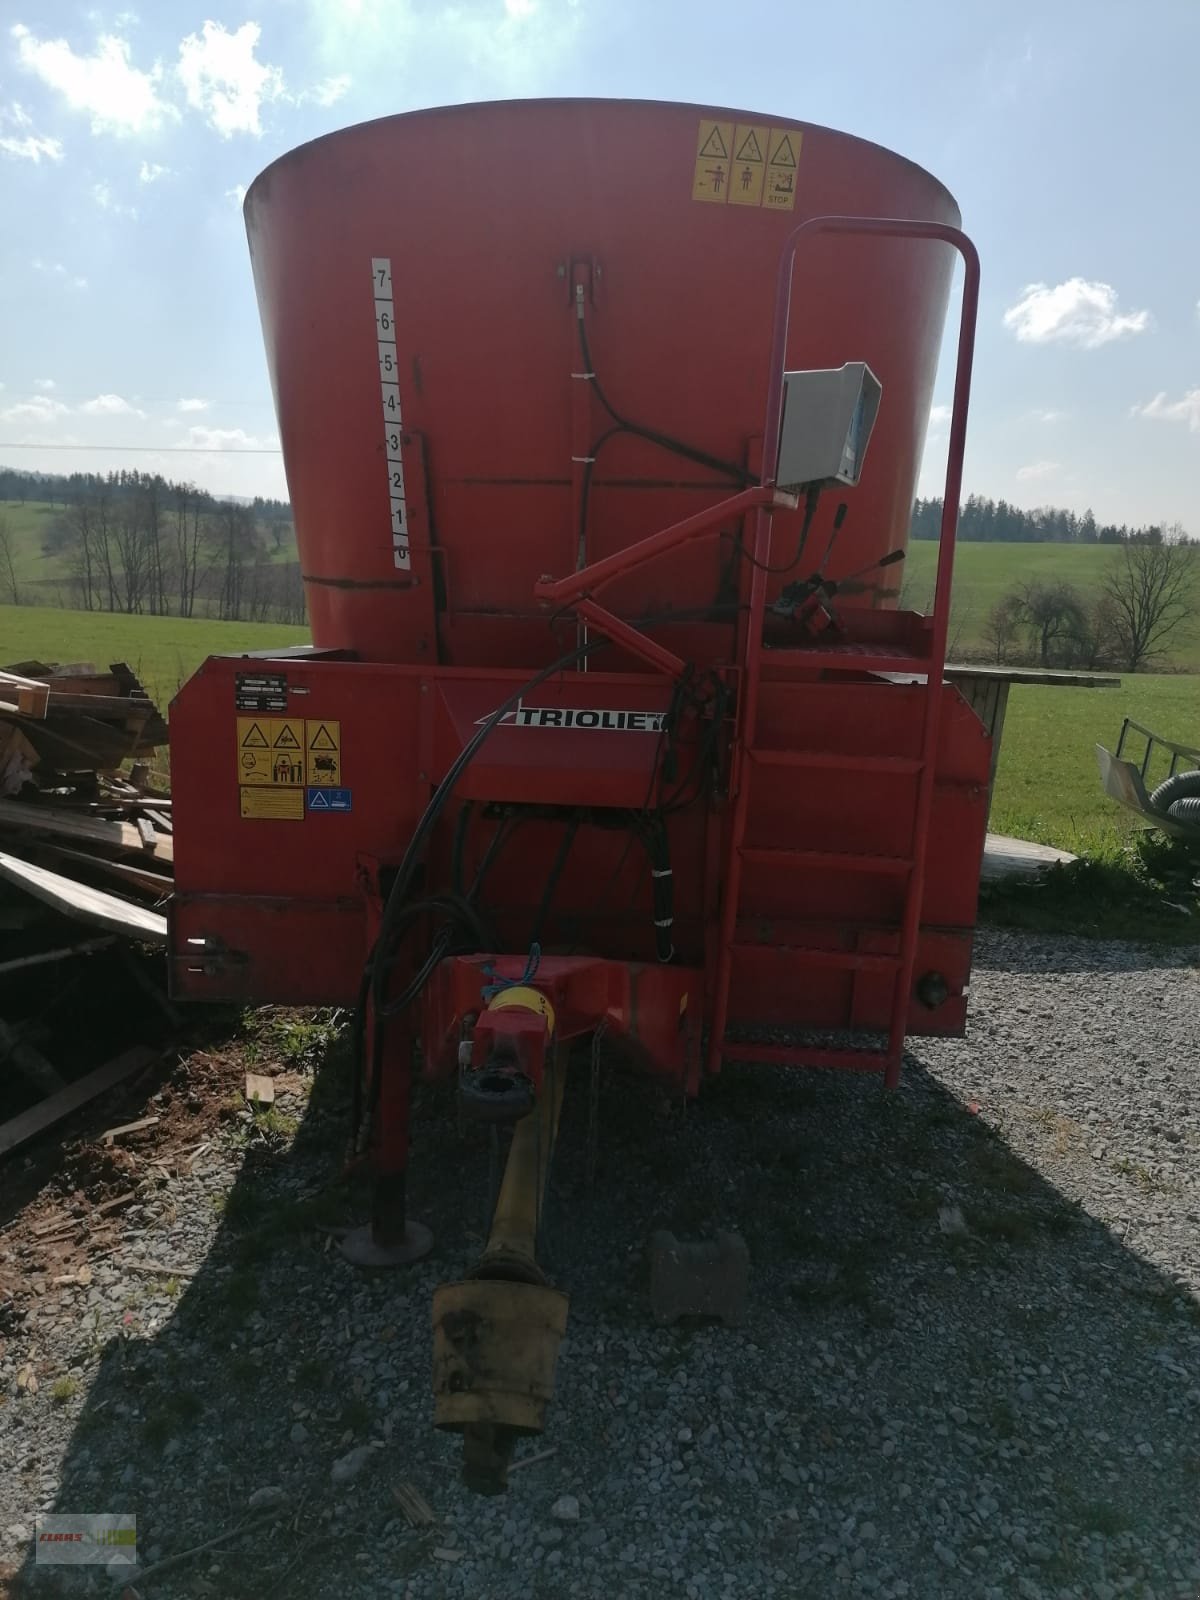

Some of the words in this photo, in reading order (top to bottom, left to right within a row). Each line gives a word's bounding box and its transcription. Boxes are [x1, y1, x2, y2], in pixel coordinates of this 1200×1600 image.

[768, 195, 788, 203] STOP
[377, 270, 386, 287] 7
[381, 313, 390, 330] 6
[384, 354, 393, 372] 5
[387, 395, 396, 412] 4
[390, 434, 399, 450] 3
[393, 472, 401, 488] 2
[396, 508, 403, 524] 1
